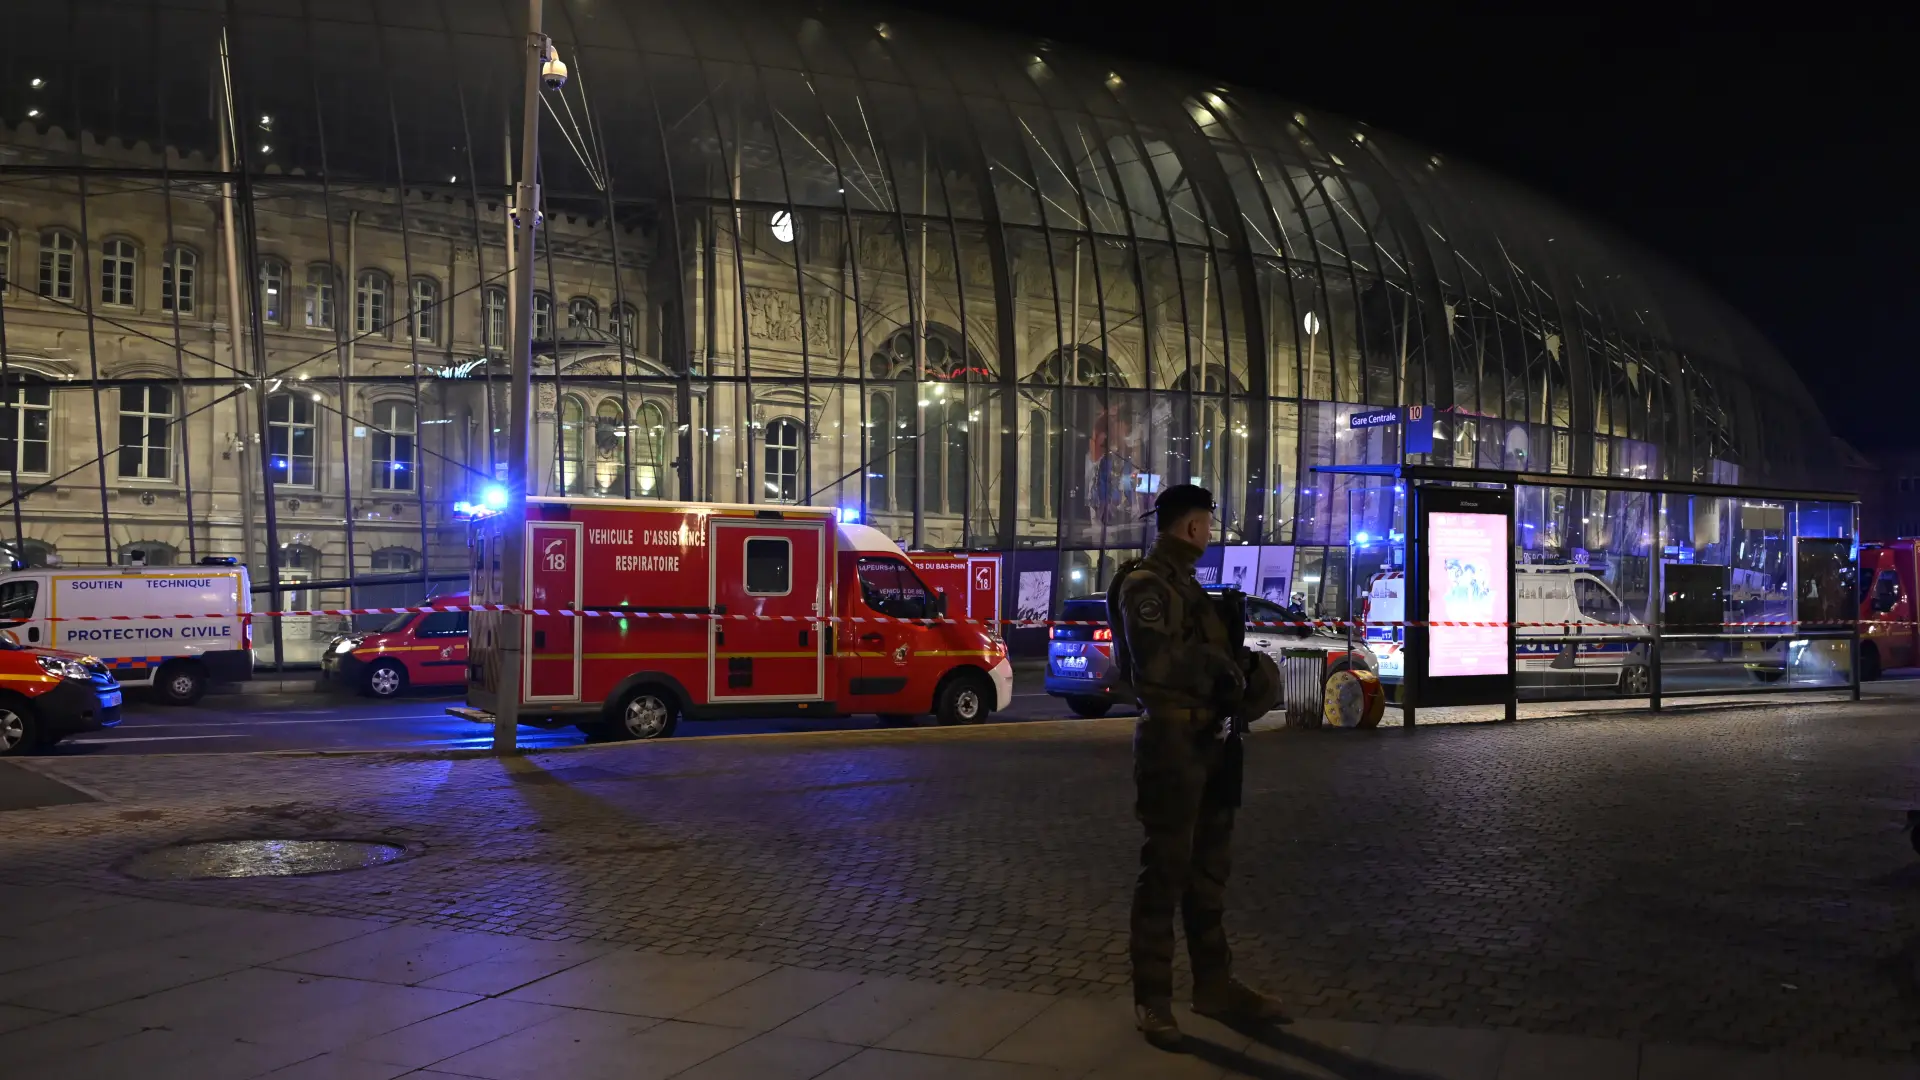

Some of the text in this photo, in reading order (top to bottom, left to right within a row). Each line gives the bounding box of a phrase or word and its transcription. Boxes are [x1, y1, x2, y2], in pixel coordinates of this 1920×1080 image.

[1352, 412, 1396, 426] Gare Centrale
[1411, 406, 1421, 419] 10
[589, 528, 634, 545] VEHICULE
[546, 553, 566, 570] 18
[615, 555, 680, 572] RESPIRATOIRE
[72, 579, 211, 590] SOUTIEN TECHNIQUE
[979, 579, 988, 589] 18
[67, 625, 231, 641] PROTECTION CIVILE
